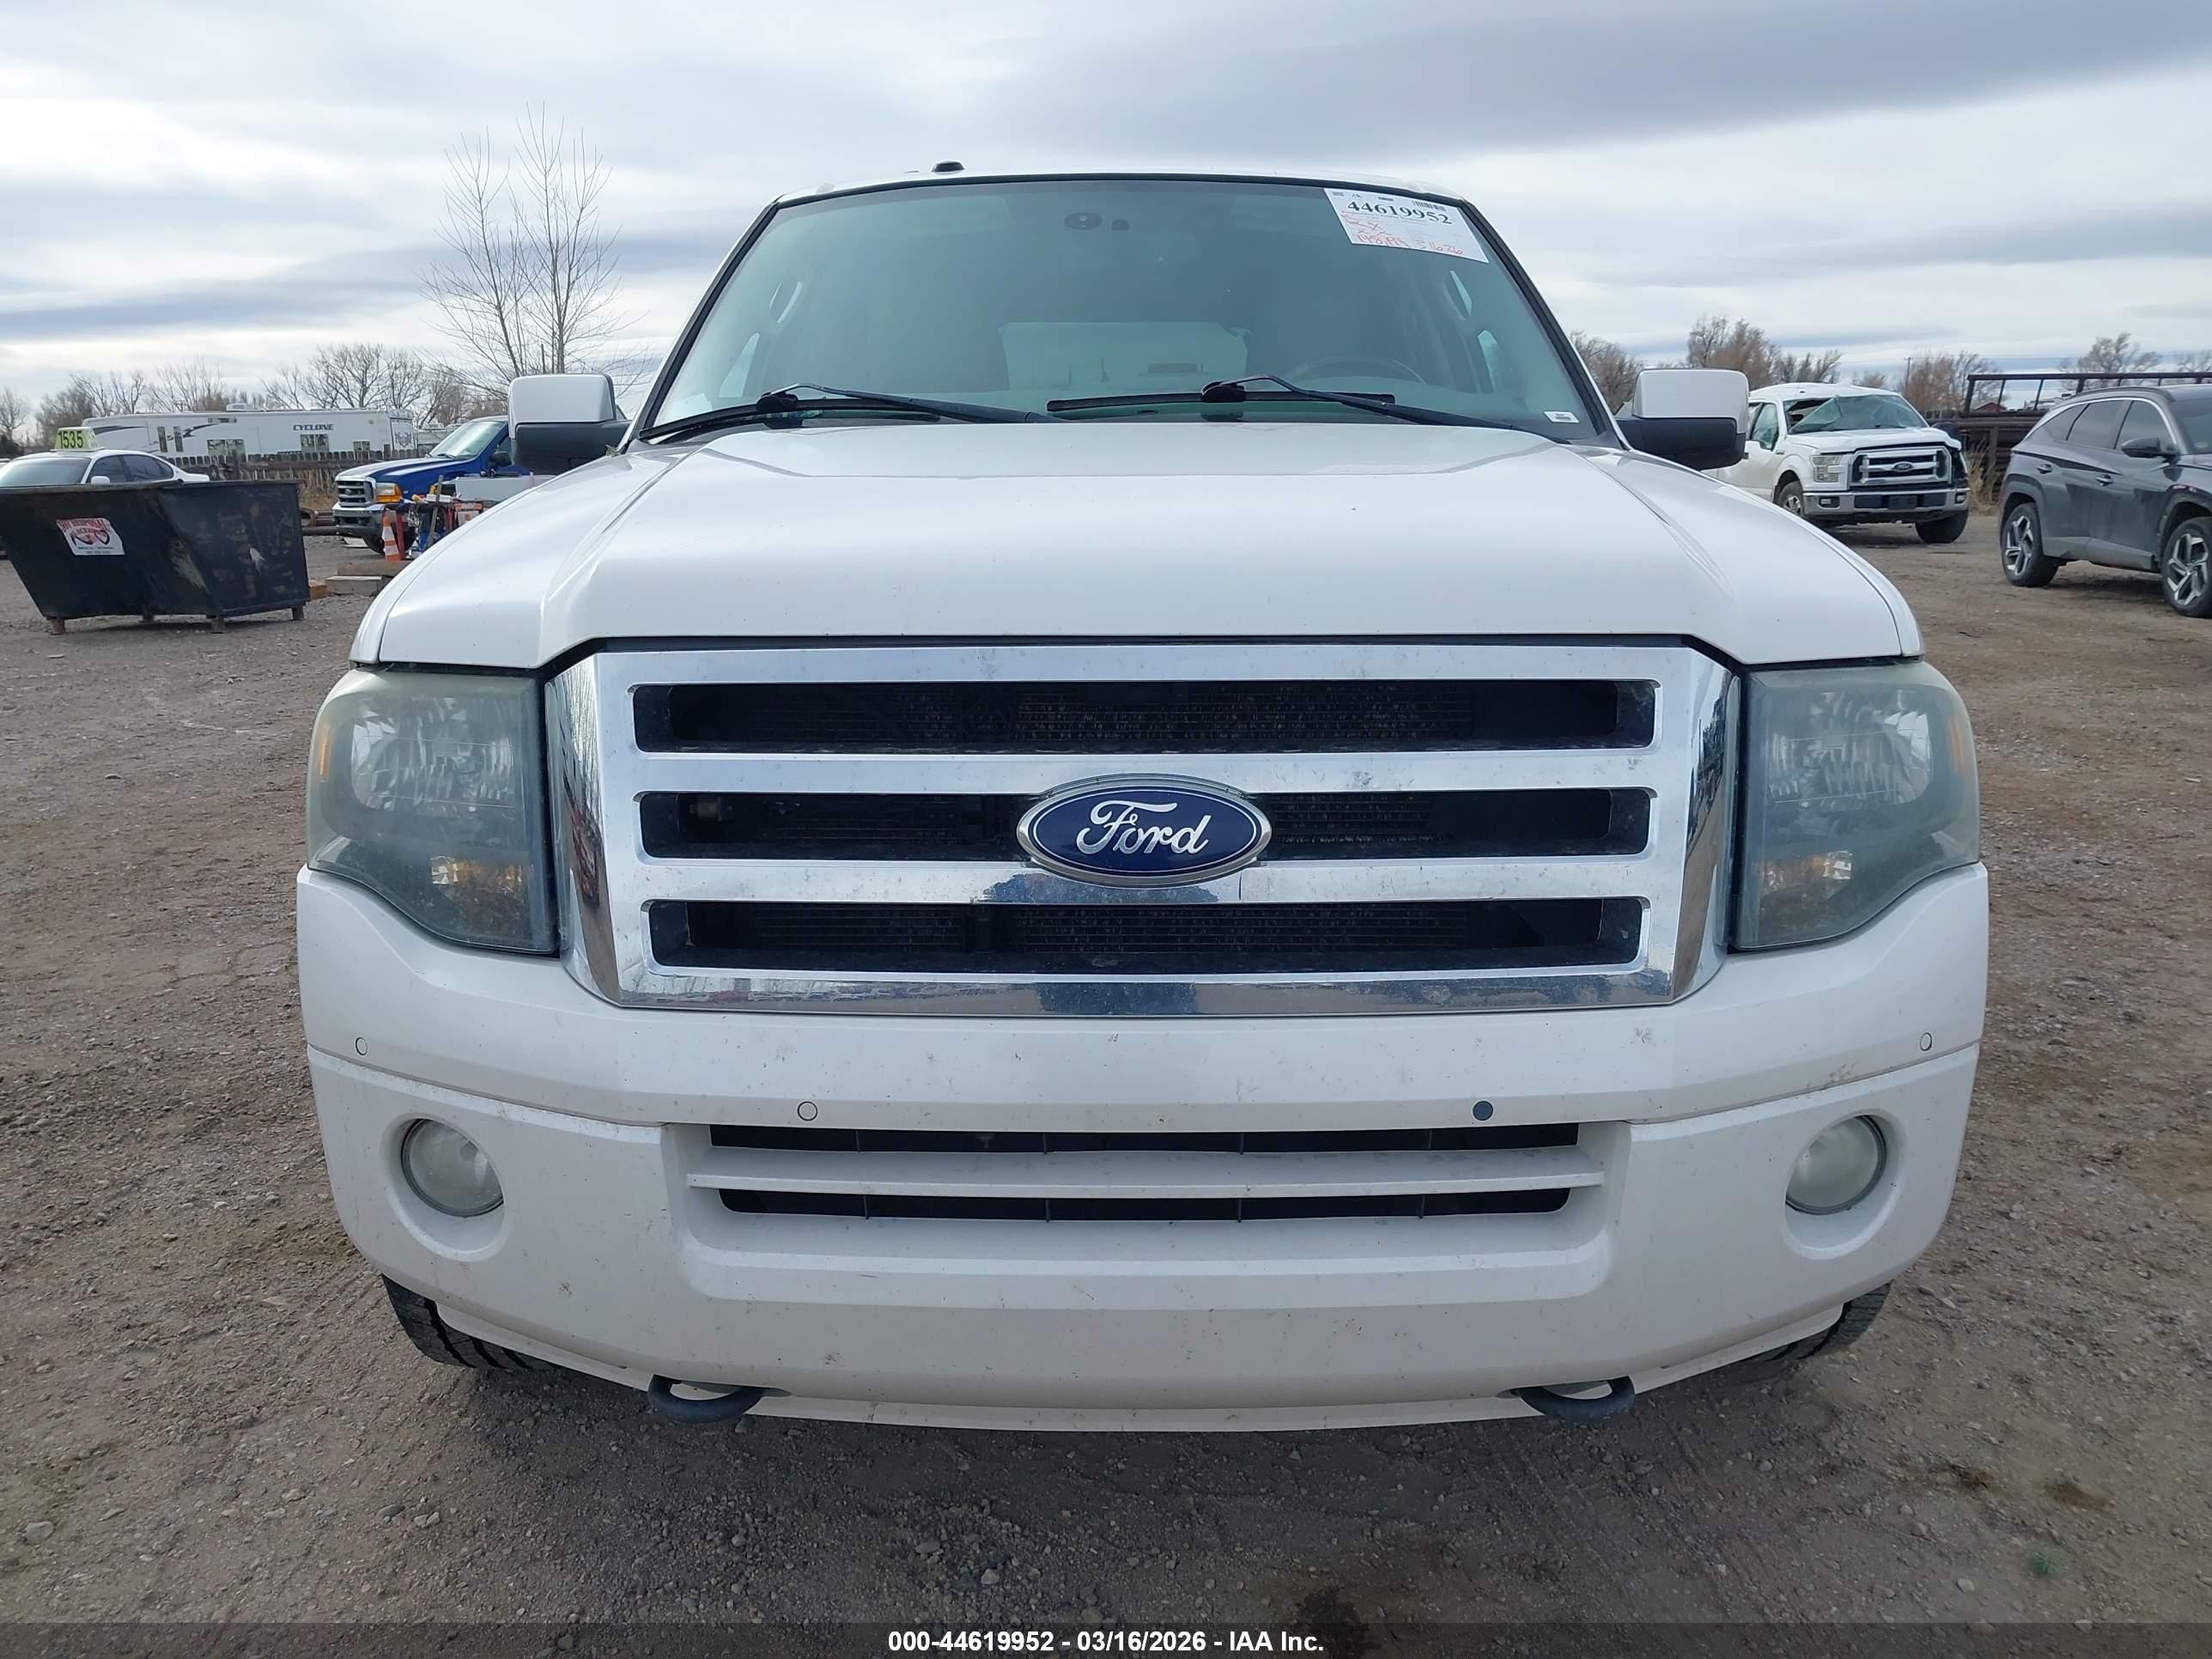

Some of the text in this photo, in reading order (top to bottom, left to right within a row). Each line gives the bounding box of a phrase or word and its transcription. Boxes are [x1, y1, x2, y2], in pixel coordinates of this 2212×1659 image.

[1347, 201, 1453, 225] 44619952
[58, 429, 83, 449] 1535
[1076, 799, 1212, 854] Ford
